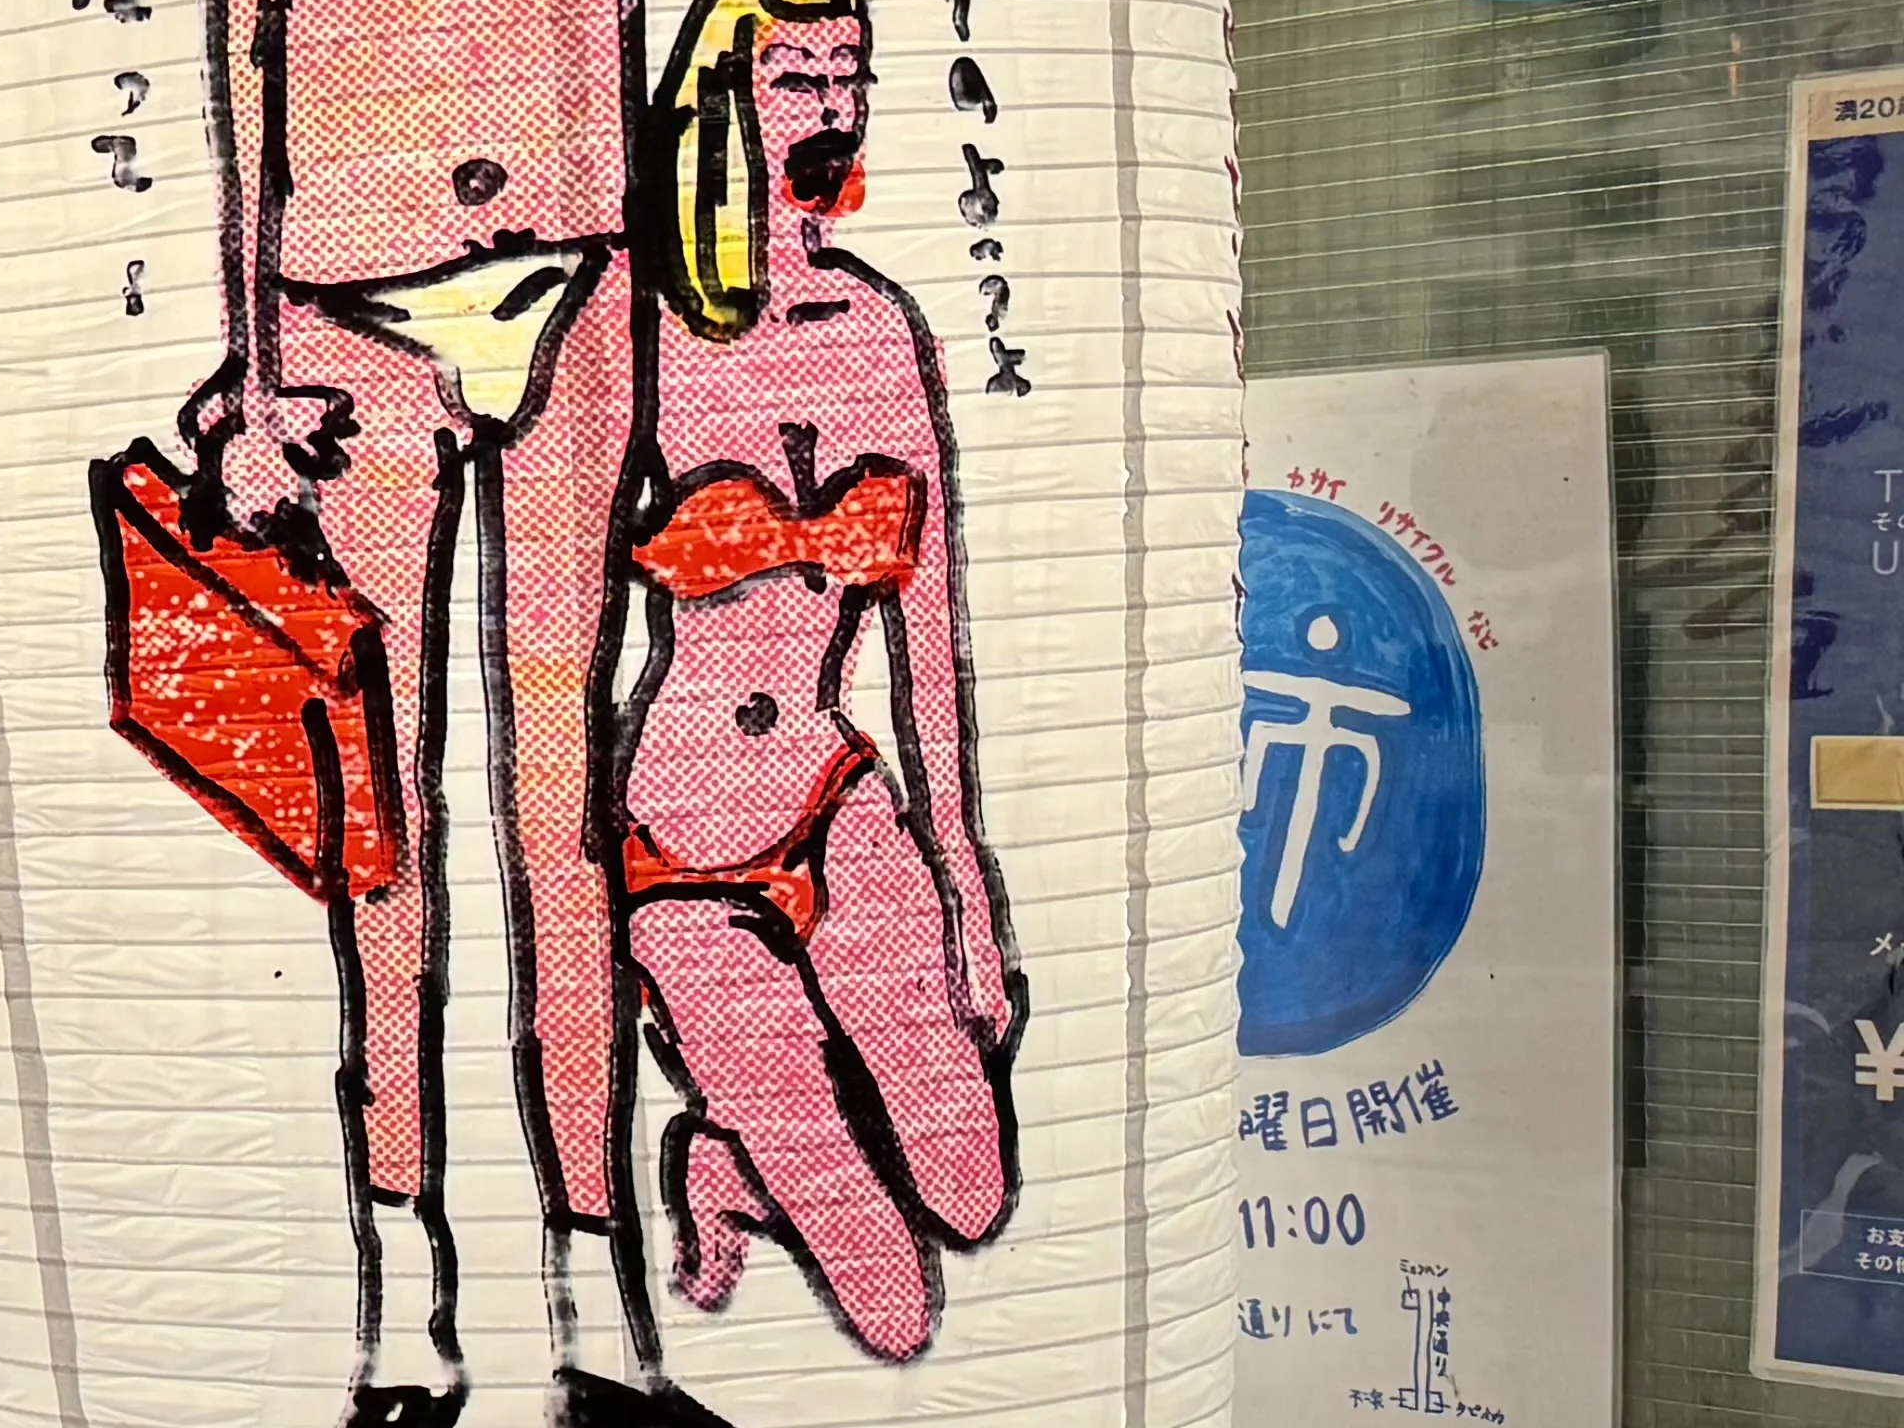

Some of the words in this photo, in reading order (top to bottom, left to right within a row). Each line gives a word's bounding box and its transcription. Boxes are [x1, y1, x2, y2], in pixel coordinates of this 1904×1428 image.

[1238, 1058, 1461, 1152] 曜日開催
[1238, 1193, 1368, 1249] 11:00
